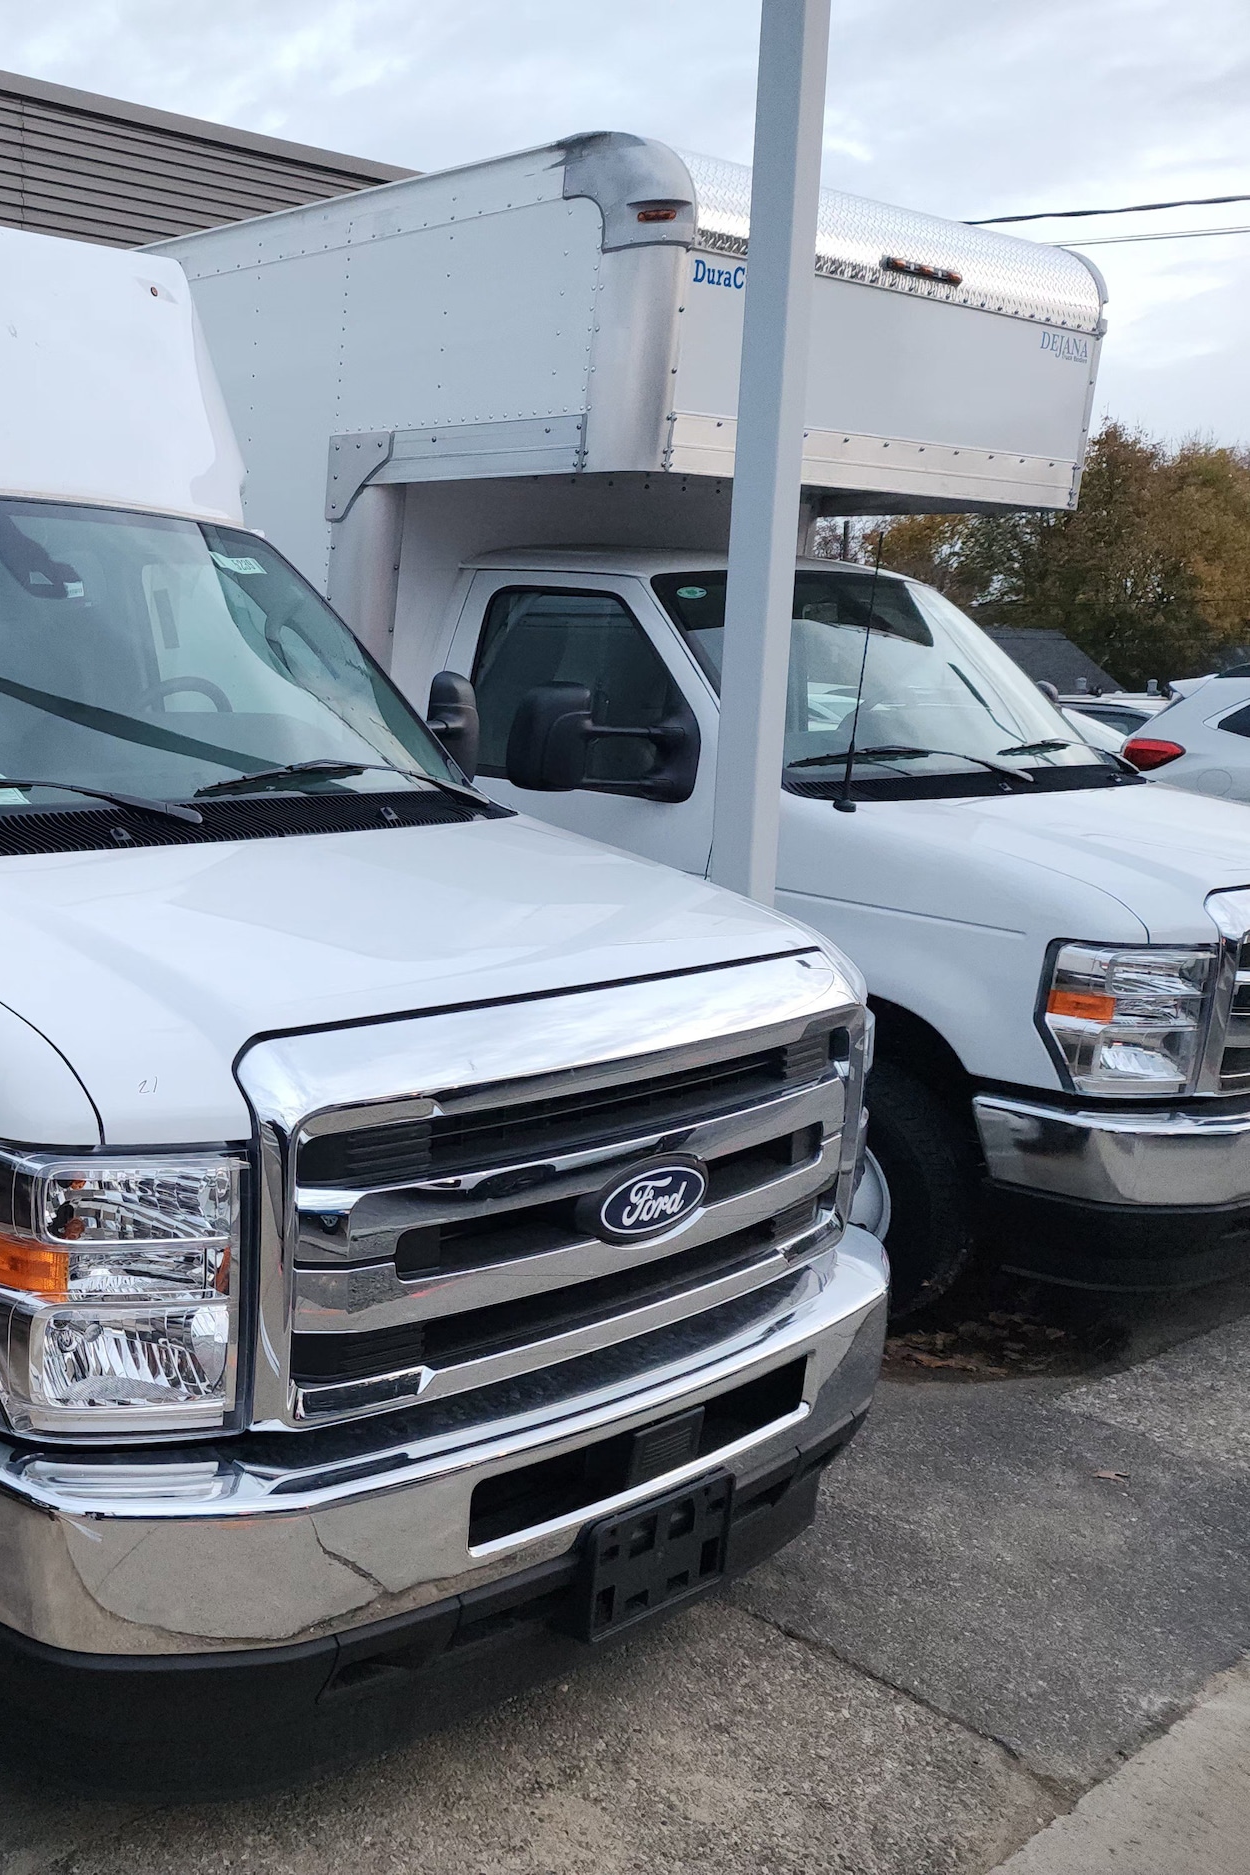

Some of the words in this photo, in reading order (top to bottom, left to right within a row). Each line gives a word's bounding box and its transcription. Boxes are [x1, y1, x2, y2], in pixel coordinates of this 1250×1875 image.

[693, 259, 746, 289] DuraC
[1040, 331, 1088, 358] DEJANA
[138, 1076, 158, 1094] 21
[621, 1175, 689, 1228] Ford
